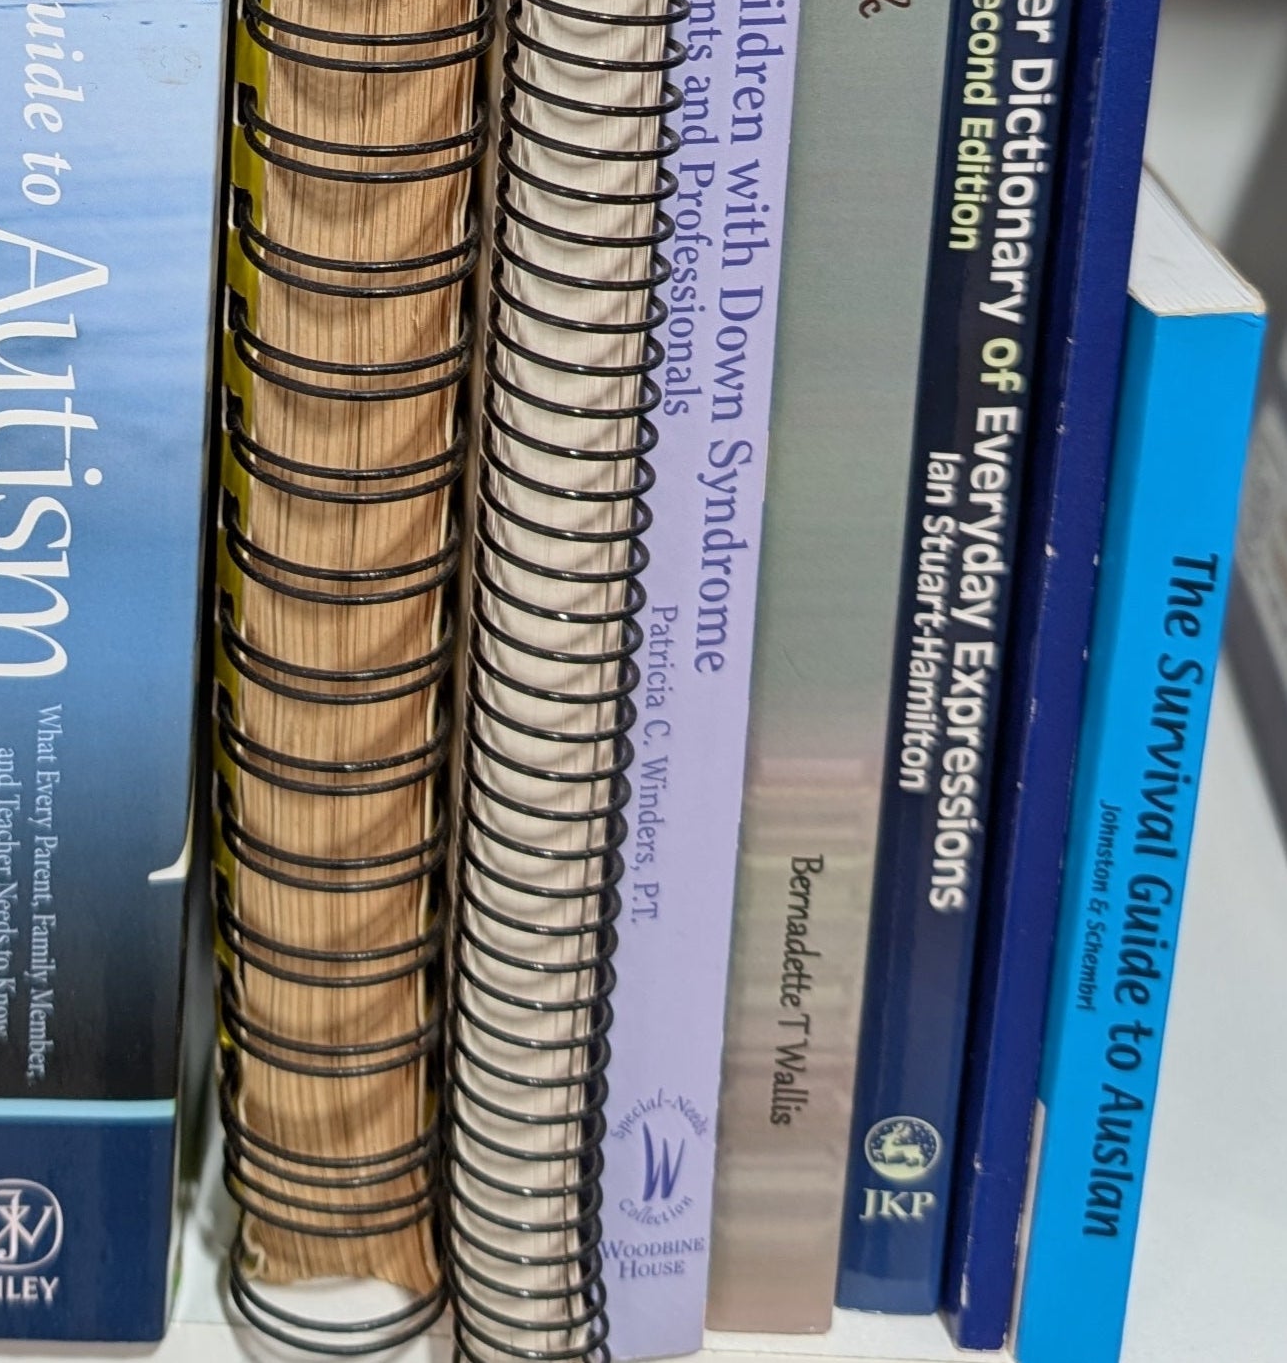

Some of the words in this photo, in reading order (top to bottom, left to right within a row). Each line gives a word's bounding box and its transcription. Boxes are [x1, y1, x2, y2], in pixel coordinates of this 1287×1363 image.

[681, 73, 719, 146] and
[22, 151, 73, 205] to
[721, 158, 771, 269] with
[949, 115, 995, 251] Edition
[979, 59, 1060, 324] Dictionary
[662, 160, 713, 418] Professionals
[711, 284, 763, 423] Down
[980, 339, 1022, 393] of
[924, 452, 962, 507] Ian
[950, 405, 1021, 628] Everyday
[693, 439, 754, 674] Syndrome
[1165, 553, 1219, 640] The
[645, 605, 679, 710] Patricia
[899, 515, 956, 793] Stuart-Hamilton
[37, 704, 63, 762] What
[642, 719, 671, 746] C.
[1135, 652, 1204, 857] Survival
[28, 770, 60, 829] Every
[630, 755, 668, 873] Winders,
[928, 641, 995, 912] Expressions
[31, 836, 58, 908] Parent,
[1099, 799, 1123, 886] Johnston
[630, 882, 659, 924] P.T.
[780, 854, 824, 1008] Bernadette
[1090, 897, 1109, 916] &
[1115, 872, 1175, 1007] Guide
[25, 913, 56, 983] Family
[1075, 922, 1107, 1013] Schembri
[26, 989, 54, 1083] Member,
[778, 1013, 810, 1035] T
[1105, 1018, 1154, 1074] to
[770, 1038, 809, 1127] Wallis
[1083, 1081, 1144, 1240] Auslan
[601, 1237, 704, 1260] WOODBINE
[619, 1195, 692, 1226] Collection
[859, 1188, 935, 1222] JKP
[619, 1259, 685, 1279] HOUSE
